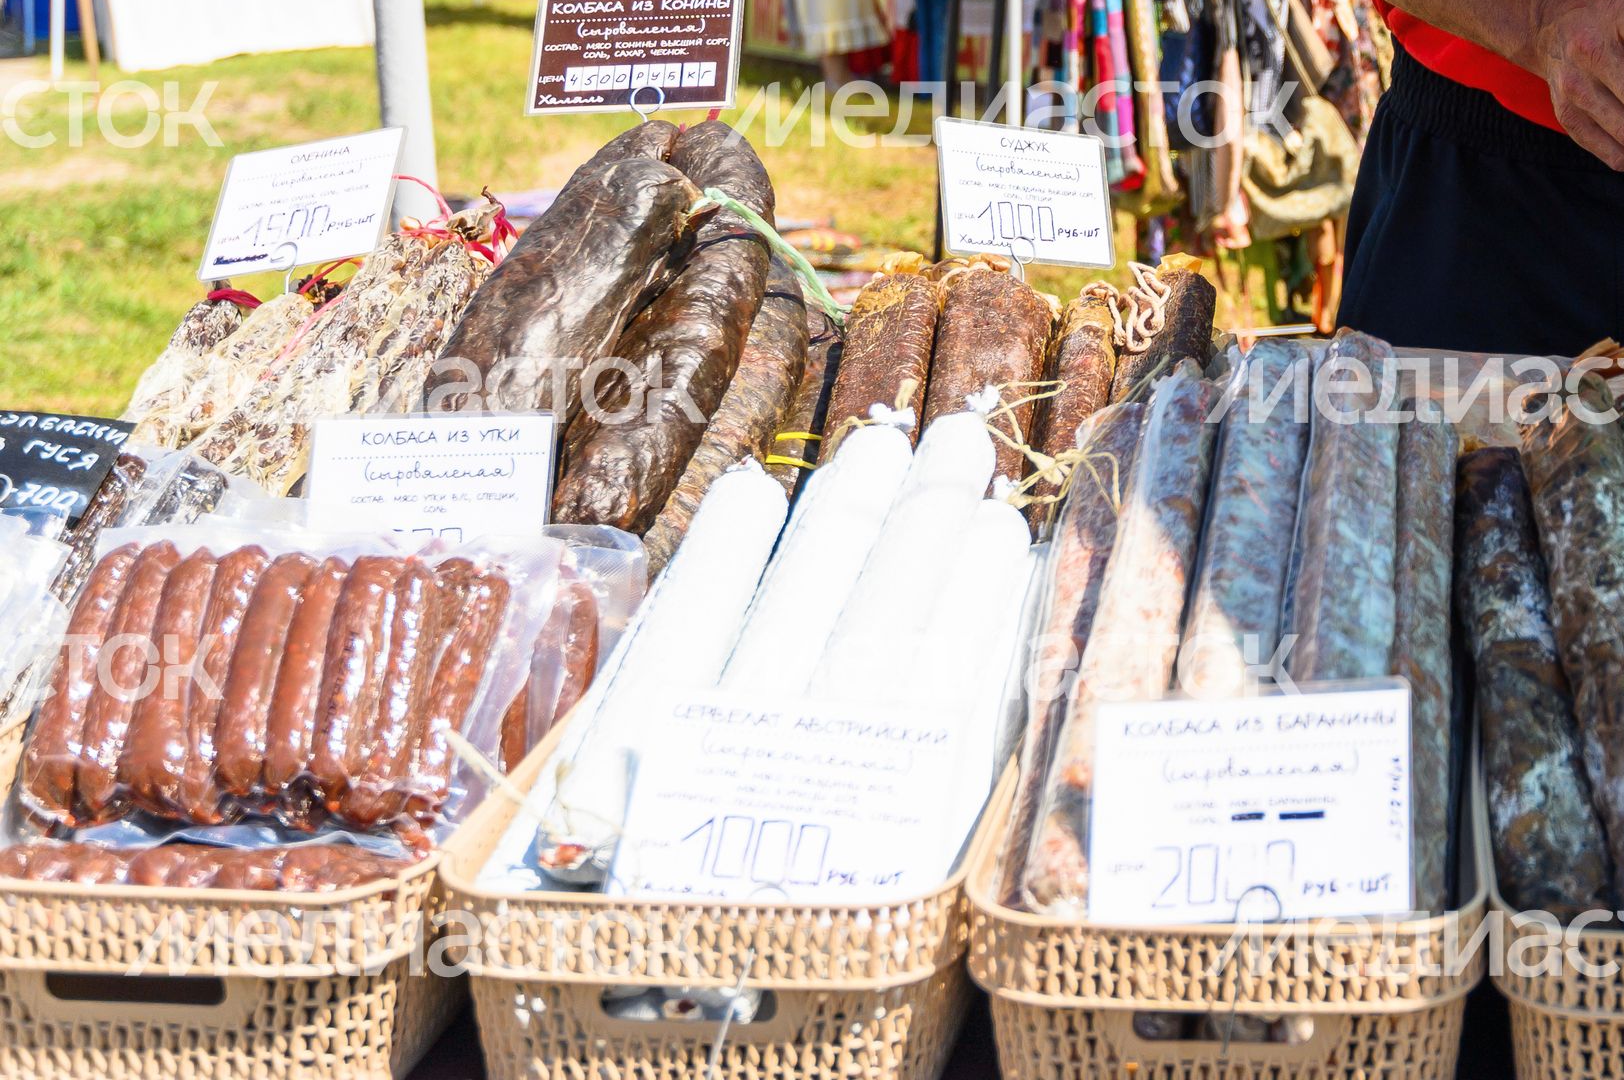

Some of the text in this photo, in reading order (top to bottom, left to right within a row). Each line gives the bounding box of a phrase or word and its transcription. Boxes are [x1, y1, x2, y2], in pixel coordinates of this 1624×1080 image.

[552, 1, 624, 14] КОЛБАСА
[632, 1, 653, 11] ИЗ
[577, 19, 705, 40] (сыровяленая)
[545, 38, 730, 51] СОСТАВ: МЯСО КОНИНЫ ВЫСШИЙ СОРТ,
[583, 48, 689, 59] СОЛЬ, САХАР, ЧЕСНОК.
[539, 75, 565, 84] ЦЕНА
[1000, 137, 1051, 153] СУДЖУК
[291, 146, 350, 164] ОЛЕНИНА
[977, 201, 1056, 242] 1000
[362, 428, 520, 446] КОЛБАСА ИЗ УТКИ
[23, 439, 100, 470] ГУСЯ
[364, 457, 515, 487] (сыровяленая)
[672, 701, 949, 745] СЕРВЕЛАТ АВСТРИЙСКИЙ
[1123, 708, 1397, 738] КОЛБАСА ИЗ БАРАНИНЫ
